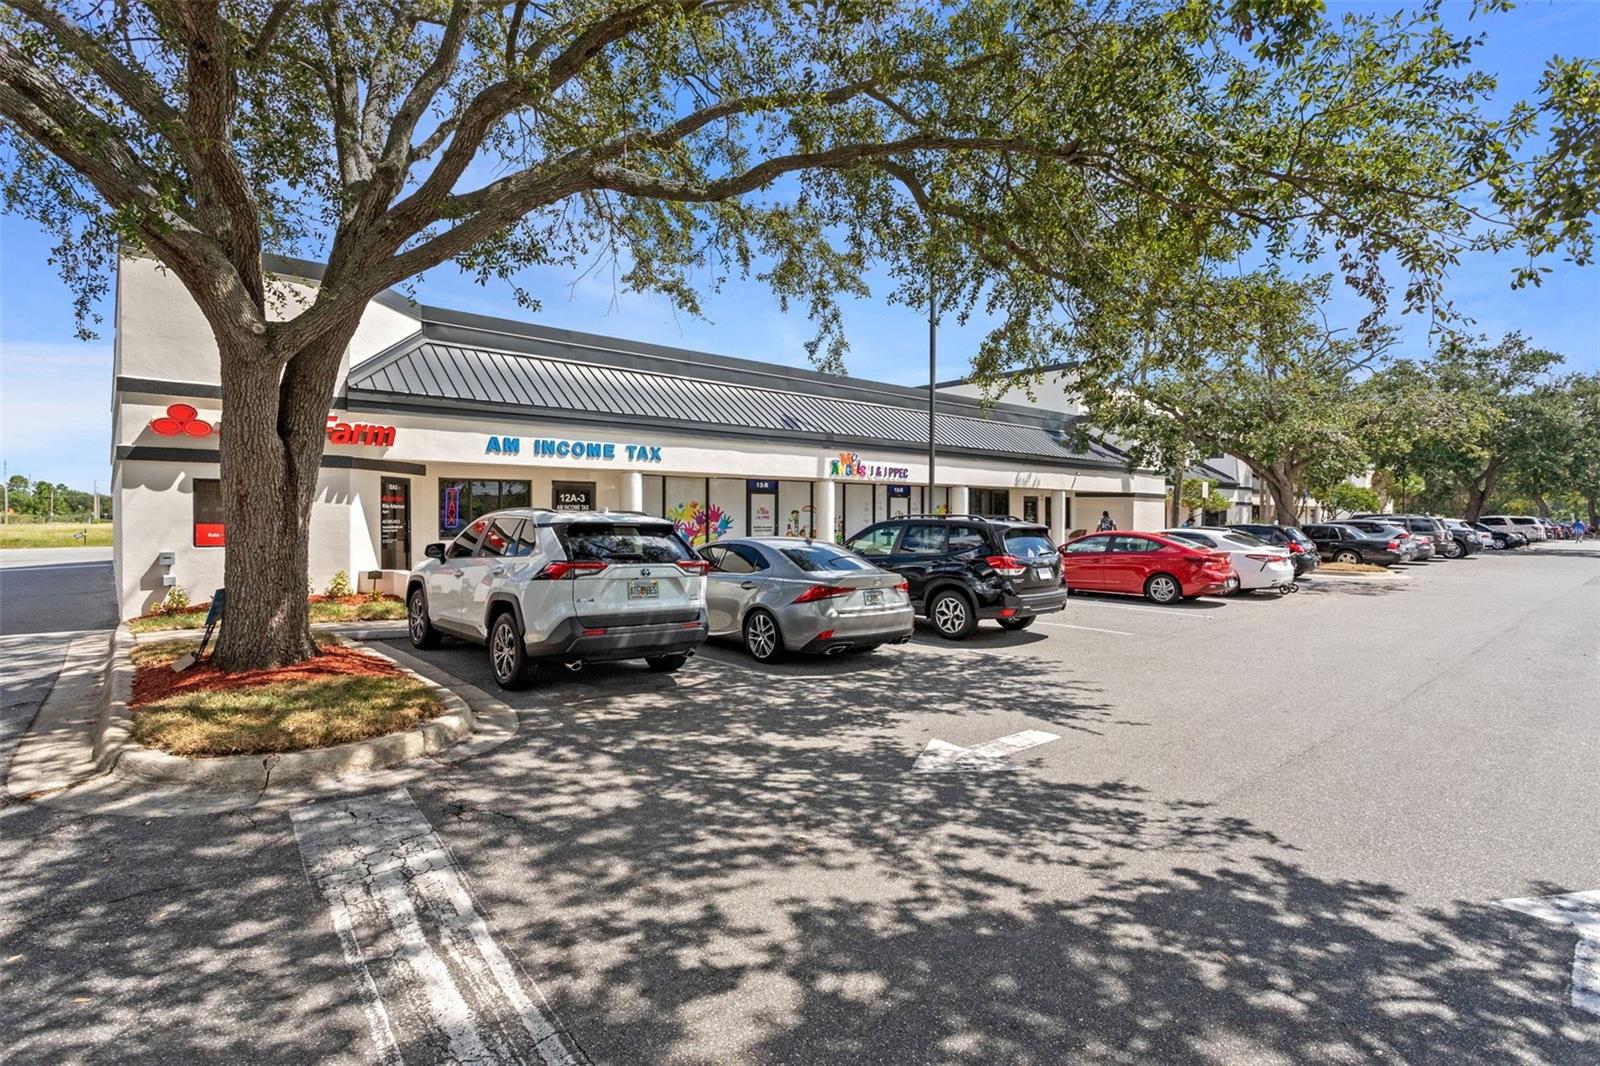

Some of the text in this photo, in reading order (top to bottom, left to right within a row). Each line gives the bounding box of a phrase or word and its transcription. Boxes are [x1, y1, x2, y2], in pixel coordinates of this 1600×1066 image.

[485, 436, 662, 462] AM INCOME TAX
[888, 467, 909, 478] PPEC
[560, 493, 586, 502] 12A-3
[447, 491, 457, 525] TAX
